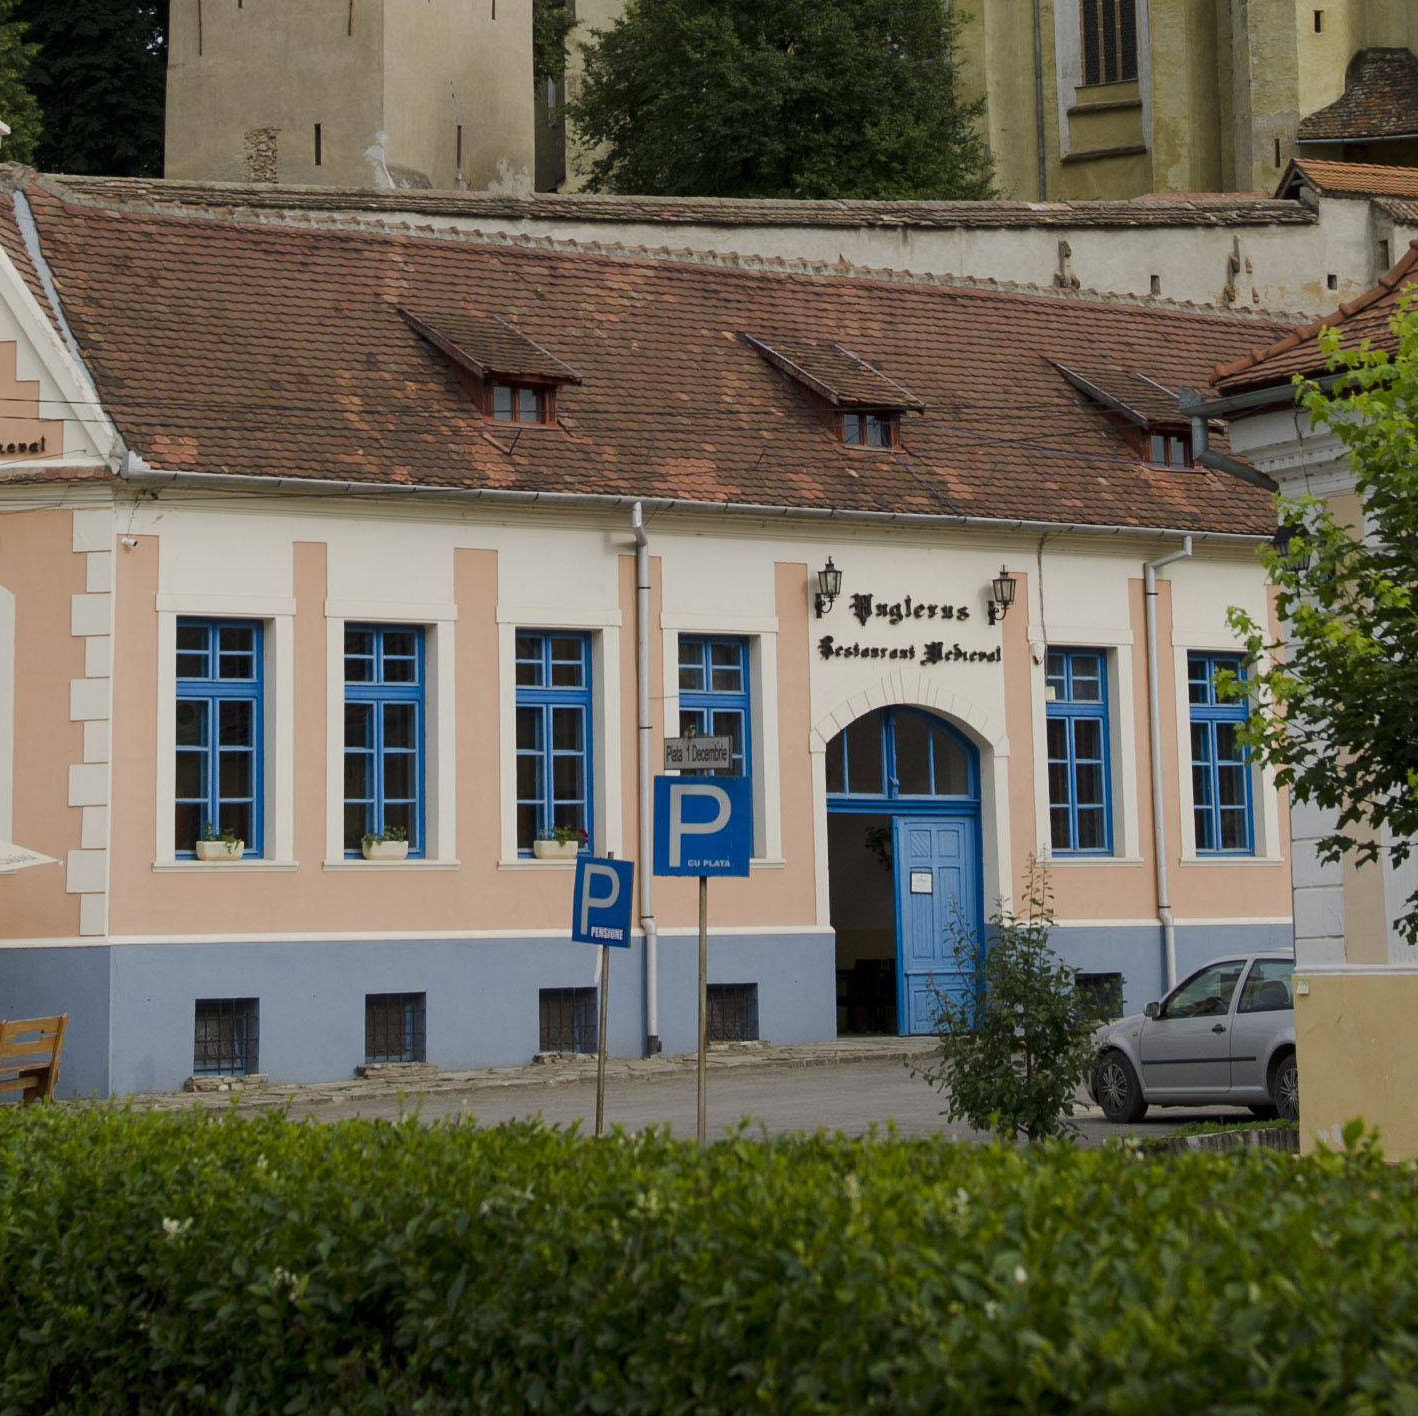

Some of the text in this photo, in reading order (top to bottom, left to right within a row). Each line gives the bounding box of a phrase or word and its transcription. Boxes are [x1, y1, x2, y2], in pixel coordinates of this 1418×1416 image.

[818, 635, 1002, 666] Restaurant Medieval
[686, 744, 690, 761] 1
[669, 784, 732, 868] P
[581, 863, 620, 935] P
